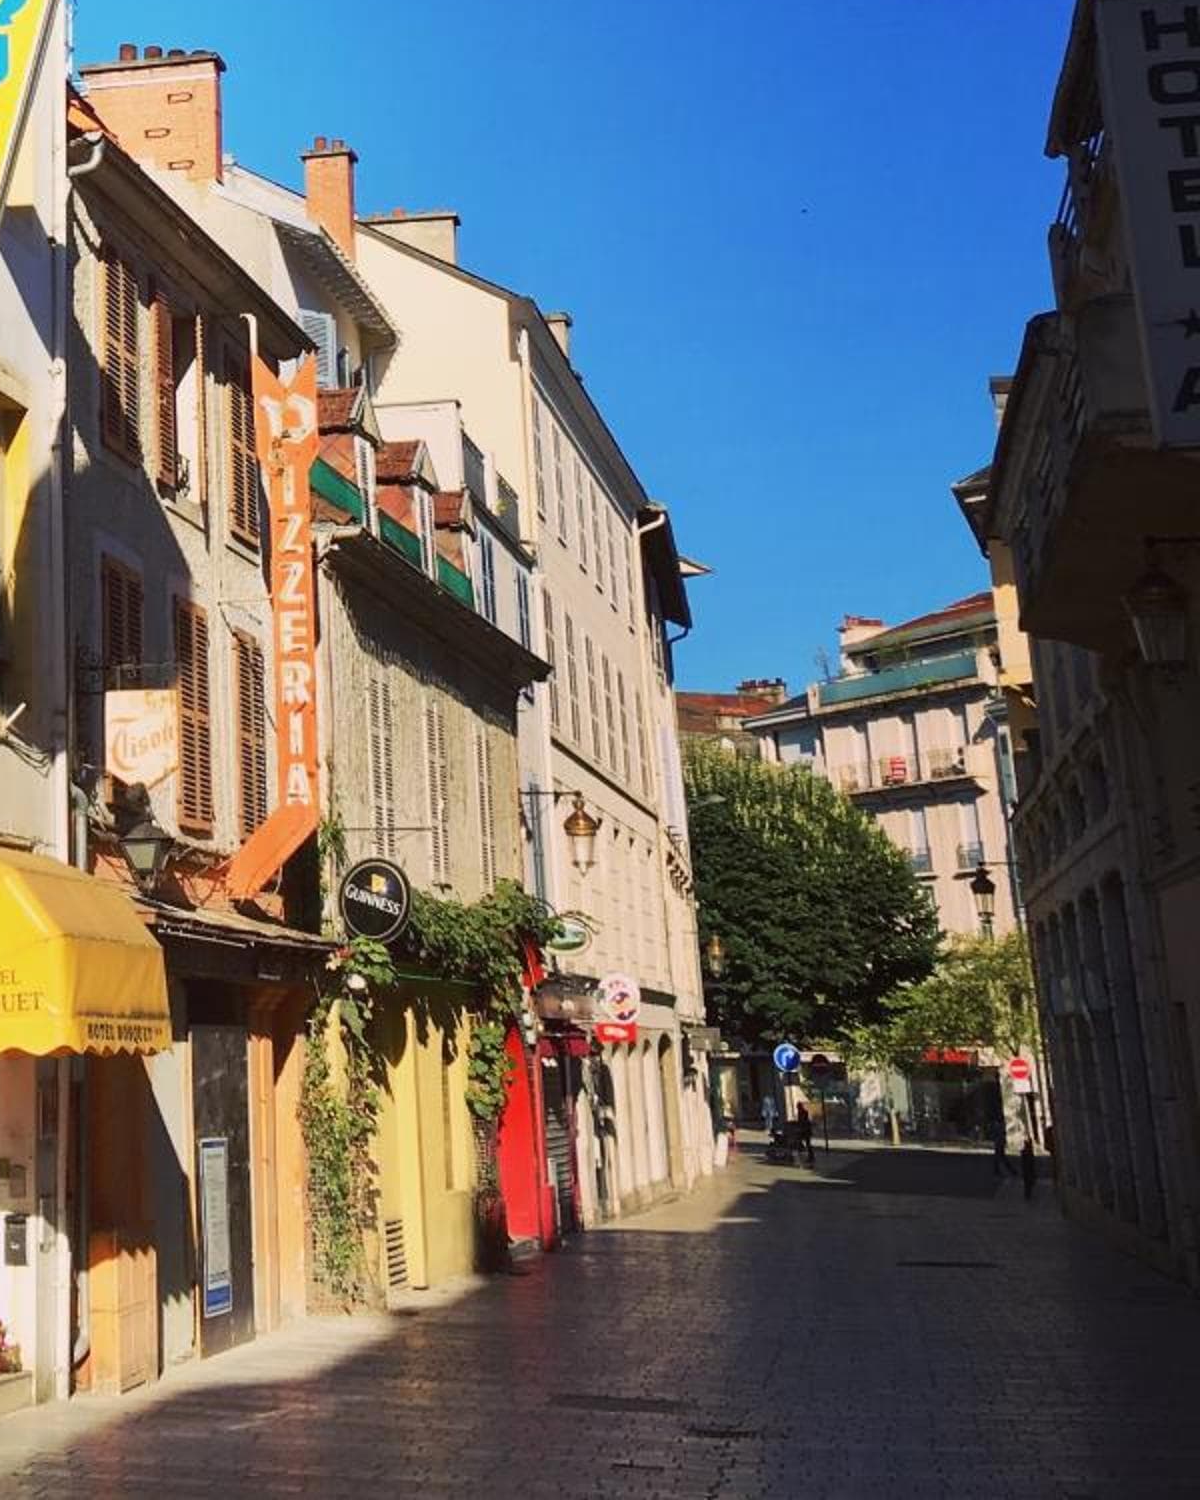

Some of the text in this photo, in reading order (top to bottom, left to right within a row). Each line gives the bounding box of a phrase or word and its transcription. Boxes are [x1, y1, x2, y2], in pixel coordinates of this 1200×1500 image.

[259, 393, 315, 805] PIZZERIA
[345, 884, 400, 915] GUINNESS
[86, 1023, 115, 1041] HOTEL
